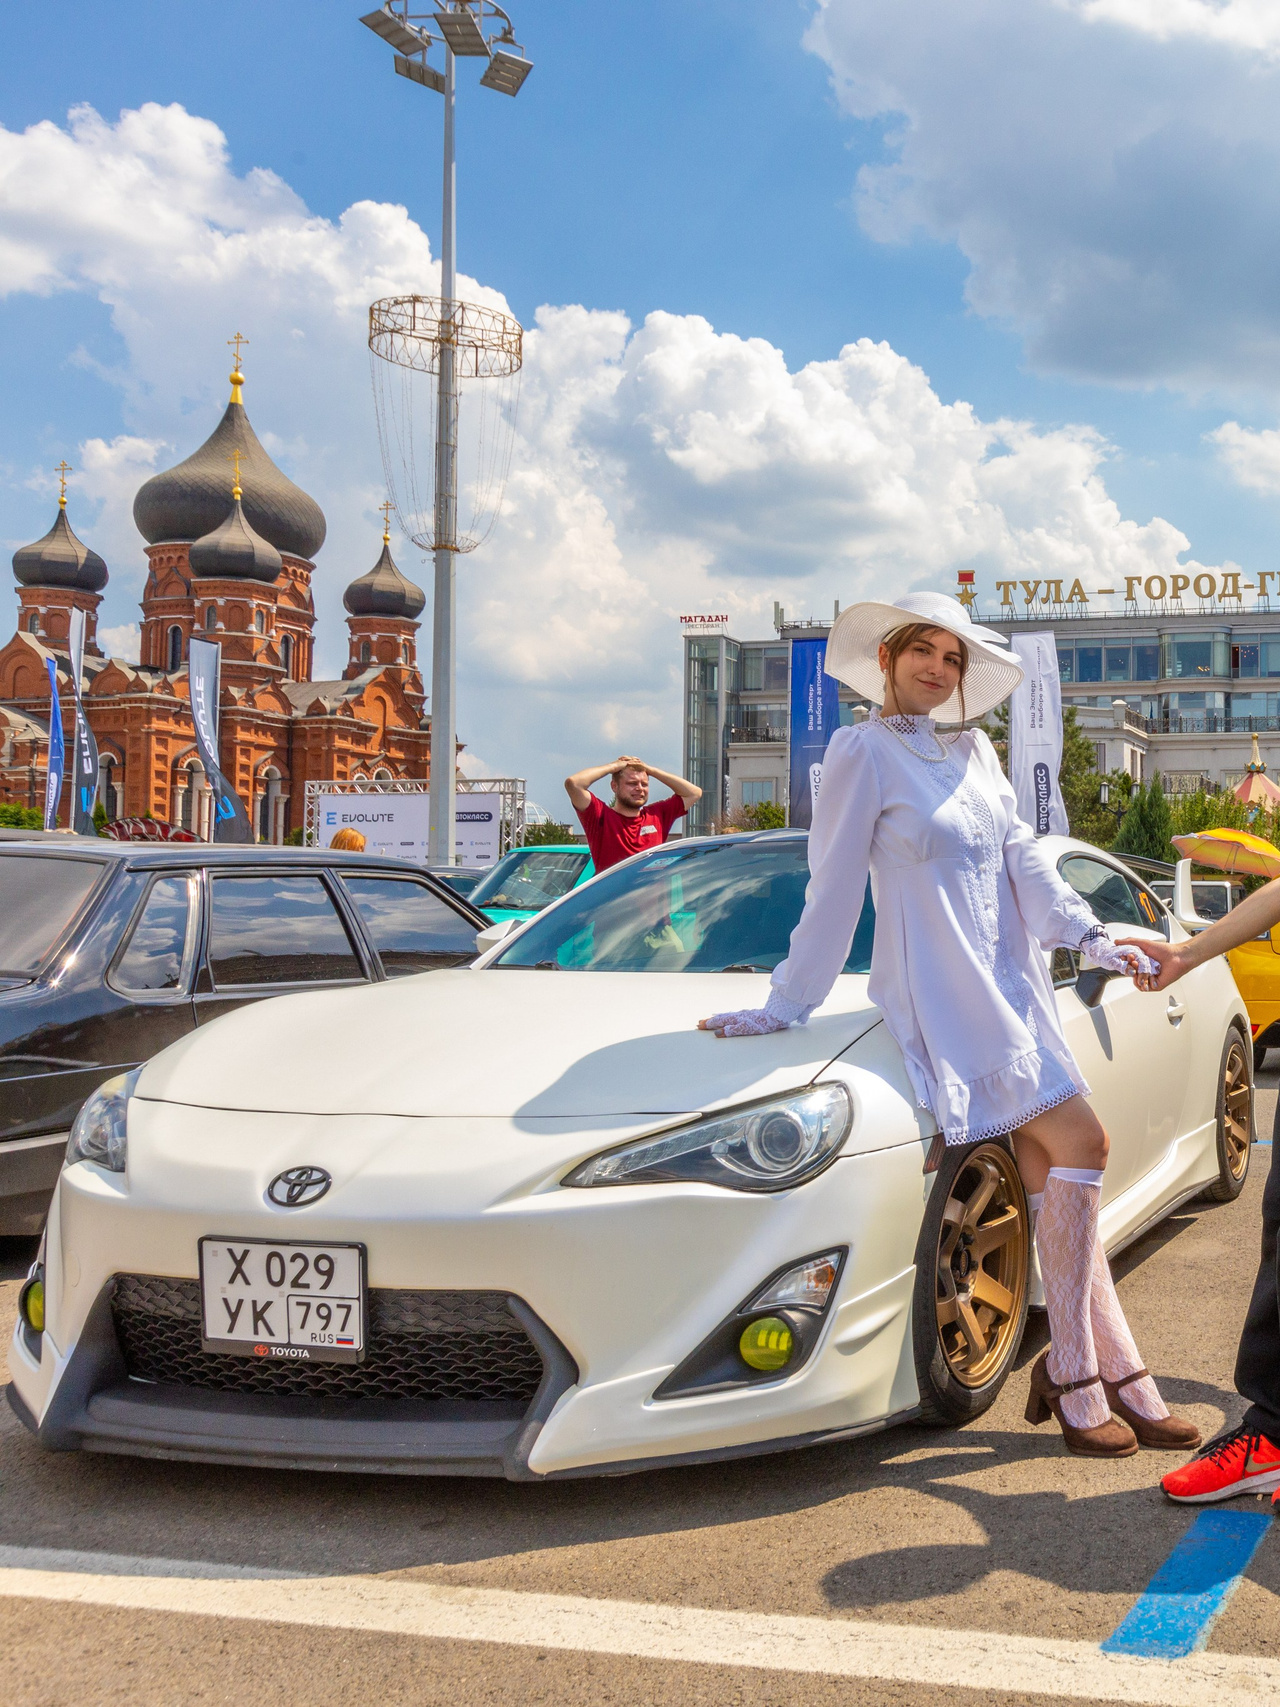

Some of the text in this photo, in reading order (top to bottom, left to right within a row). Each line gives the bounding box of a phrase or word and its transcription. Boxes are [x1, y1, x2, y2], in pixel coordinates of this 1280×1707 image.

[996, 578, 1089, 605] ТУЛА
[680, 614, 728, 623] МАГАДАН
[815, 697, 823, 724] выборе
[341, 813, 394, 823] EVOLUTE
[456, 813, 489, 821] ВТОКЛАСС
[265, 1251, 335, 1290] 029
[295, 1301, 352, 1332] 797
[310, 1333, 334, 1344] RUS
[270, 1346, 310, 1358] TOYOTA
